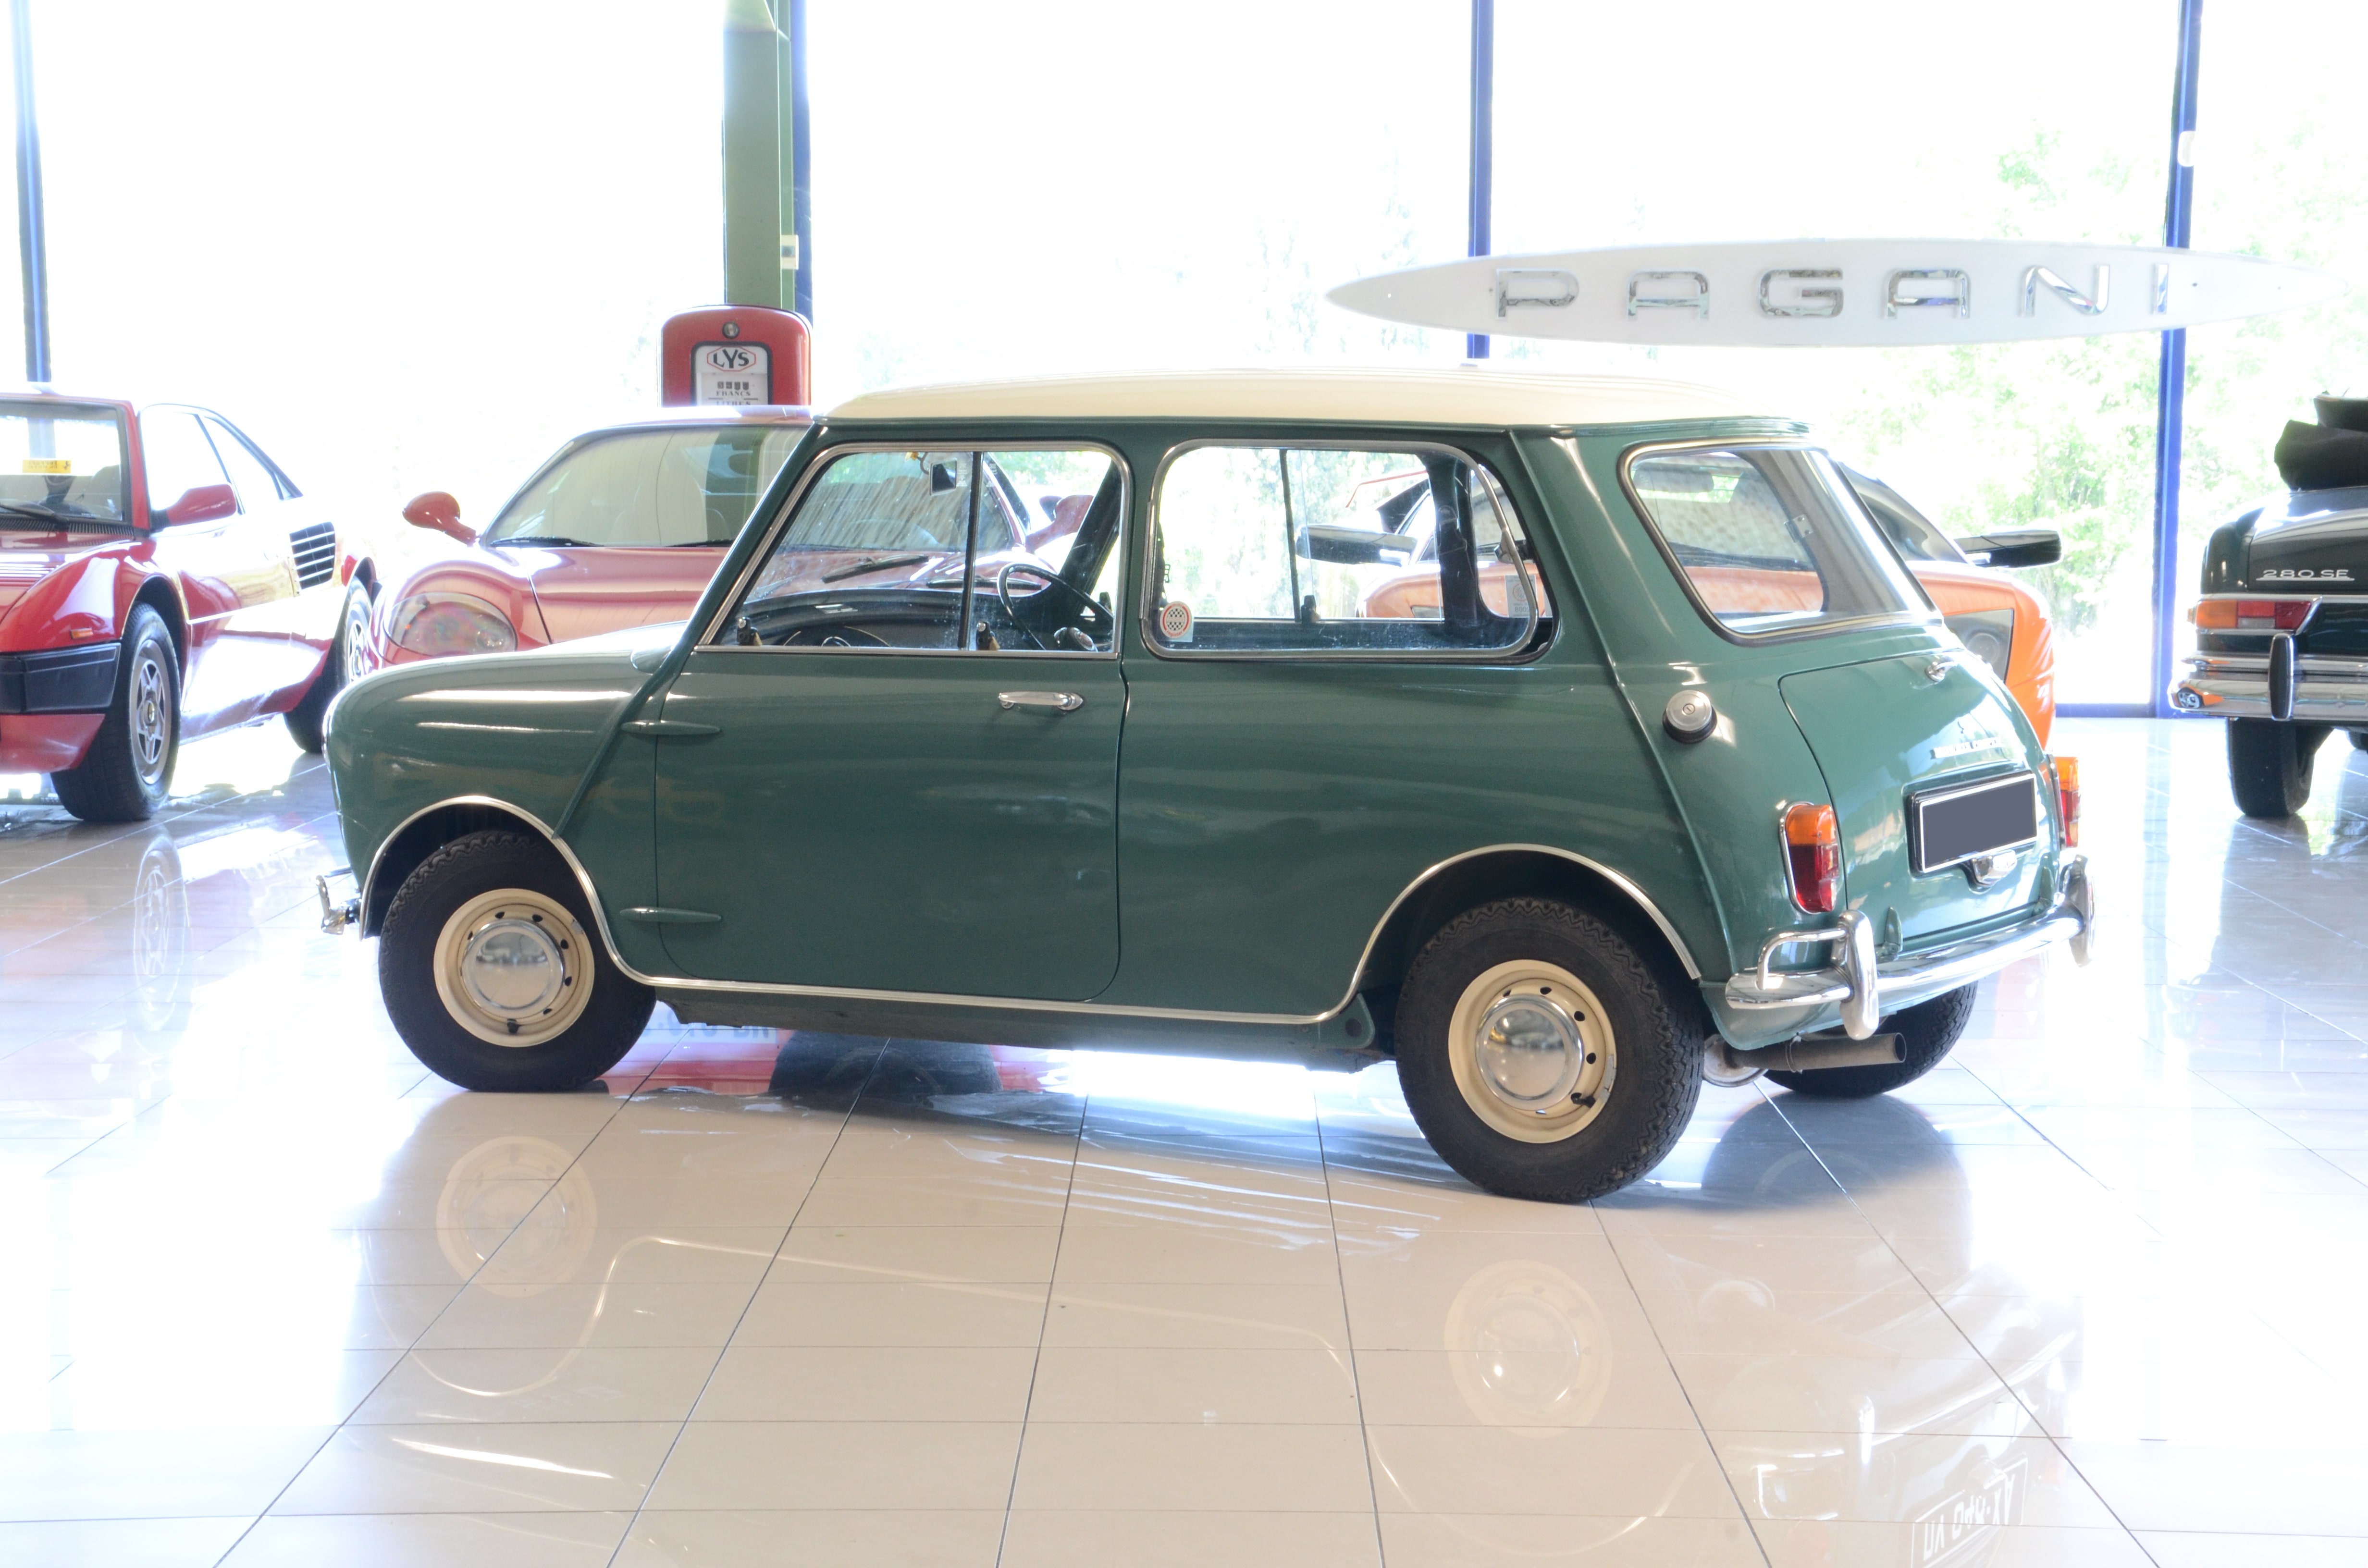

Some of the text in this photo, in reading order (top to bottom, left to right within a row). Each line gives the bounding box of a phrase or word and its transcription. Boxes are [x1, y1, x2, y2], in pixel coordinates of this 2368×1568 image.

[1496, 263, 2168, 319] PAGANI
[713, 348, 750, 369] LYS
[2263, 569, 2349, 578] 280 SE
